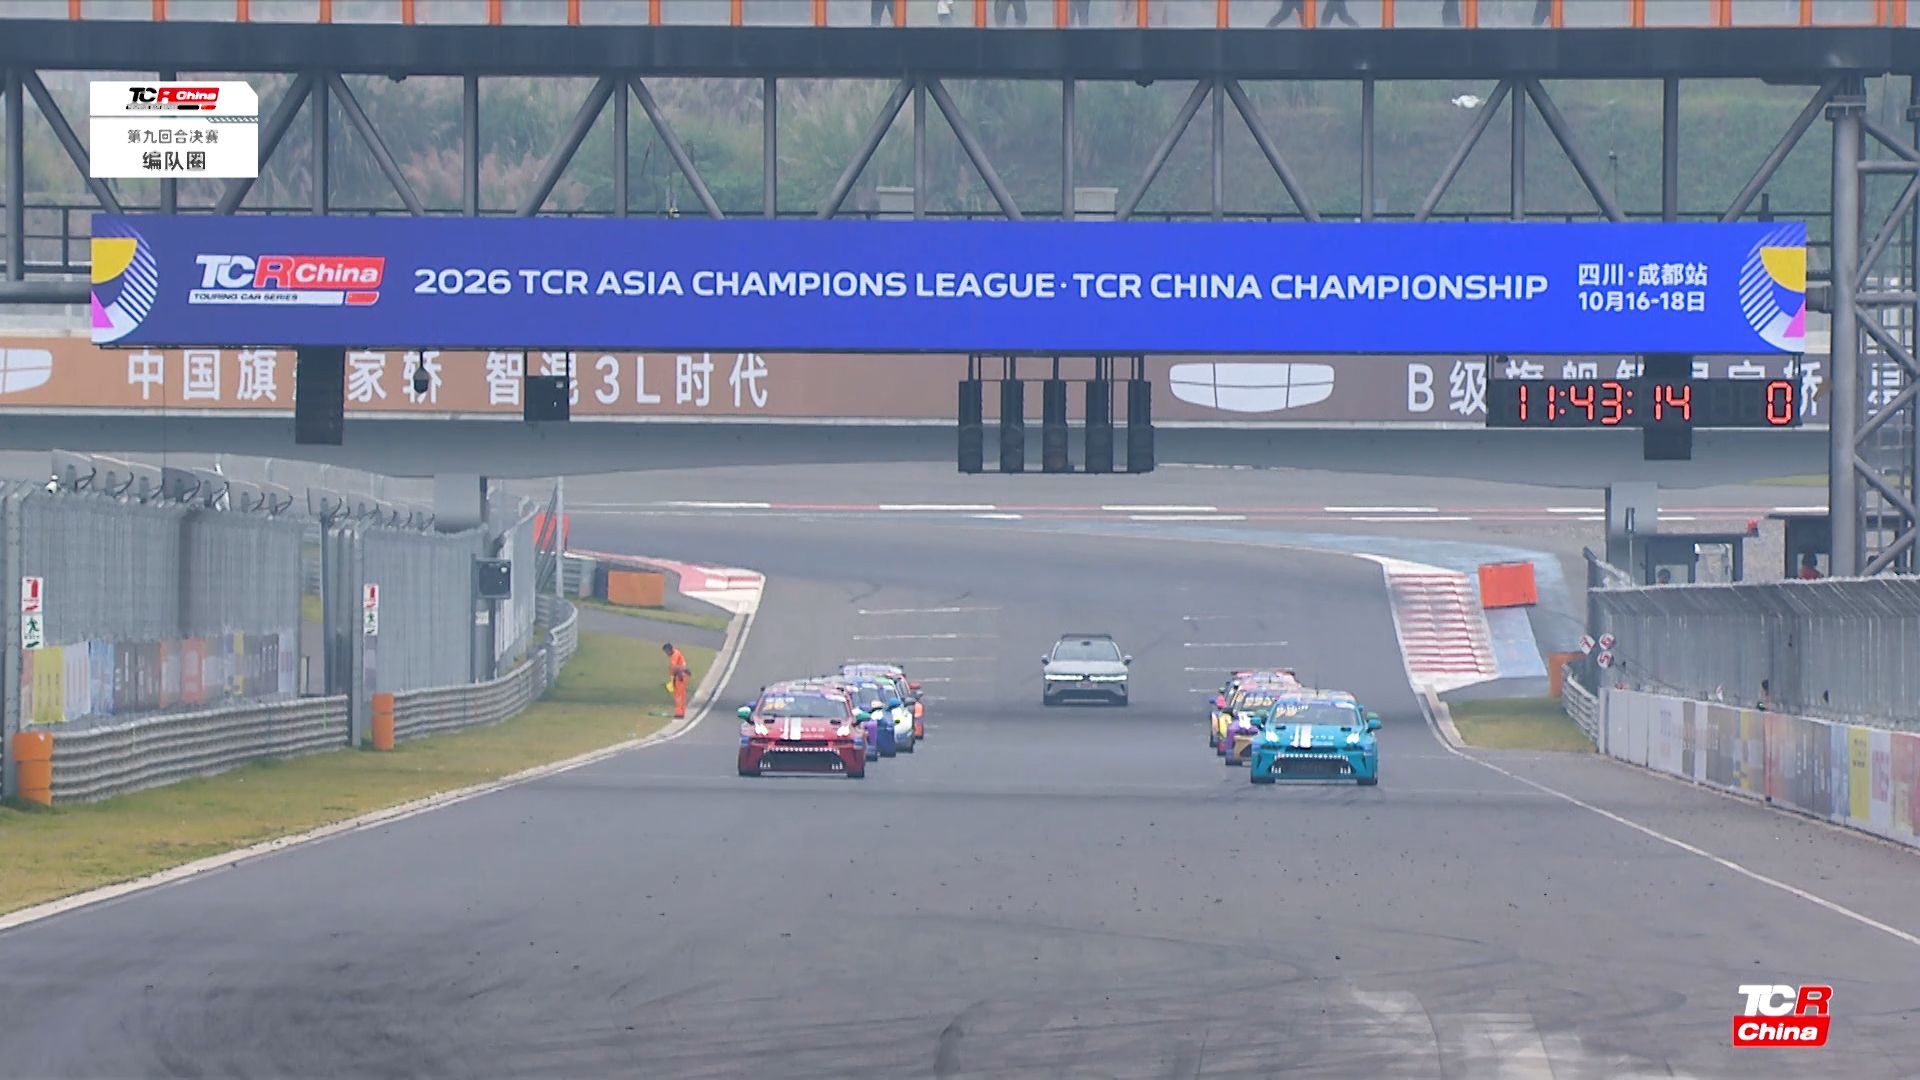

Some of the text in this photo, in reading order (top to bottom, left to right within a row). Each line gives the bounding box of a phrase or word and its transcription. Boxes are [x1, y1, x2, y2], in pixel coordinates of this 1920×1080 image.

[195, 254, 379, 289] TCR China
[414, 269, 512, 295] 2026
[519, 270, 588, 295] TCR
[596, 271, 684, 296] ASIA
[693, 271, 907, 297] CHAMPIONS
[1150, 274, 1262, 299] CHINA
[1271, 275, 1548, 300] CHAMPIONSHIP
[1578, 263, 1709, 287] 四川·成都站
[193, 293, 299, 301] TOURING CAR SERIES
[1578, 291, 1706, 312] 10月16-18日
[128, 349, 442, 404] 中国旗家轿
[1766, 382, 1792, 424] 0
